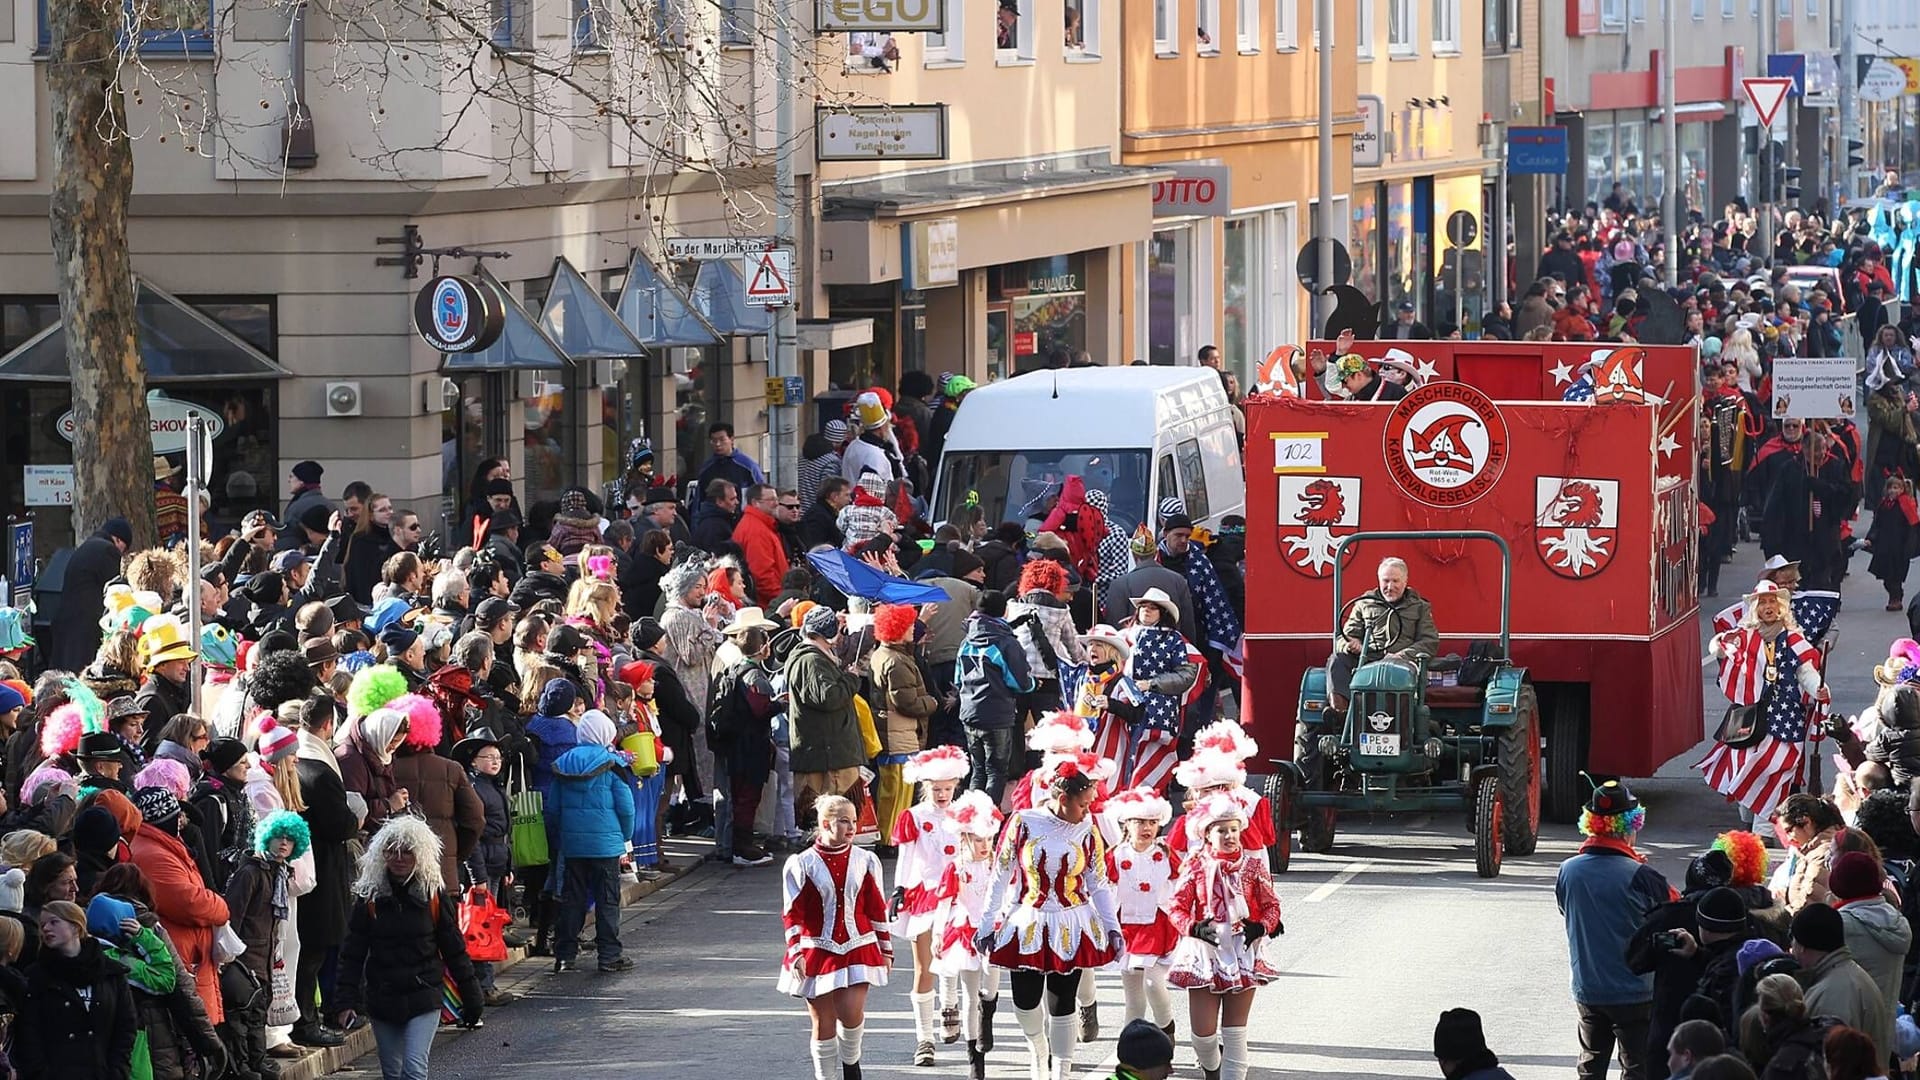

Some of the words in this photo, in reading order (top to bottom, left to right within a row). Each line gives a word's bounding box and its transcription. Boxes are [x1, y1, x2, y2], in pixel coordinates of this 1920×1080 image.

[1352, 132, 1377, 141] tudio
[1353, 143, 1365, 152] st
[670, 242, 681, 254] An
[685, 242, 699, 254] der
[704, 242, 768, 255] Martinikirch
[1398, 386, 1495, 421] MASCHERODER
[1284, 443, 1312, 460] 102
[1389, 438, 1503, 502] KARNEVALGESELLSCHAFT
[1369, 736, 1381, 744] PE
[1366, 746, 1371, 754] V
[1376, 746, 1394, 754] 842
